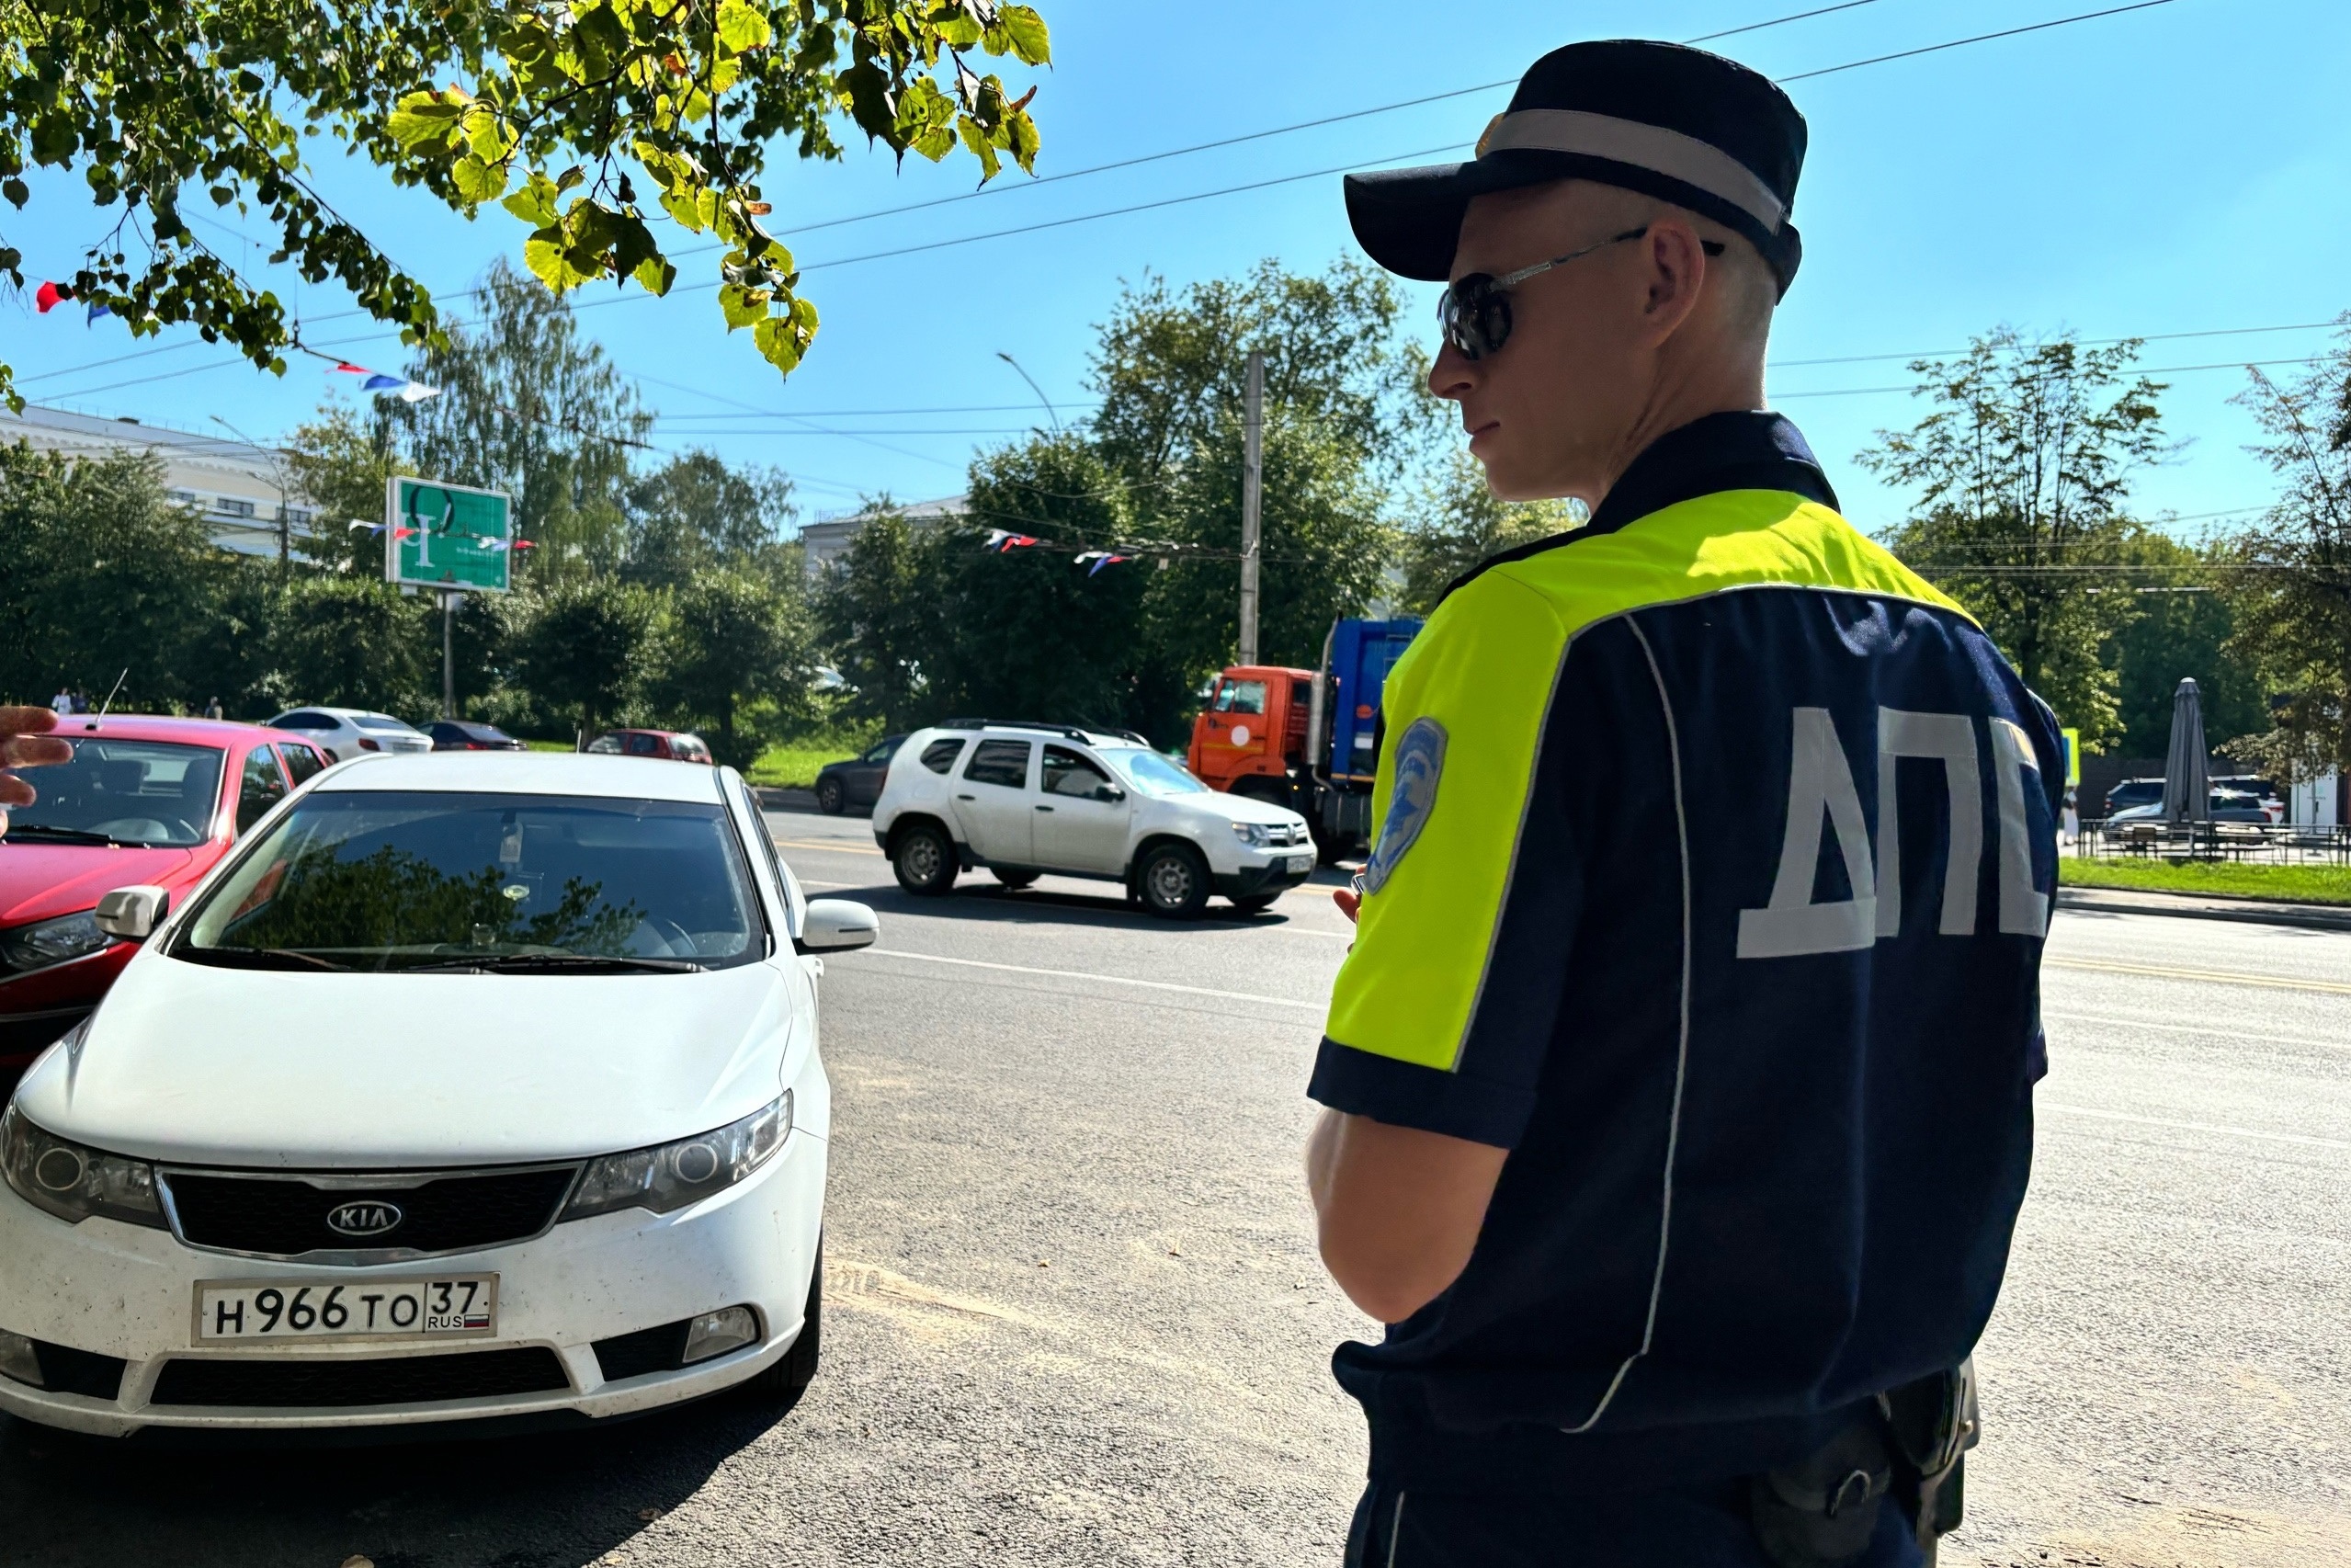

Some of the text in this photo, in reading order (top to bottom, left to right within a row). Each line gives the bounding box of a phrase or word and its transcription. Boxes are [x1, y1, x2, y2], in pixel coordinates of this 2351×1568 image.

[339, 1208, 388, 1227] KIA
[431, 1281, 479, 1315] 37
[428, 1315, 462, 1329] RUS
